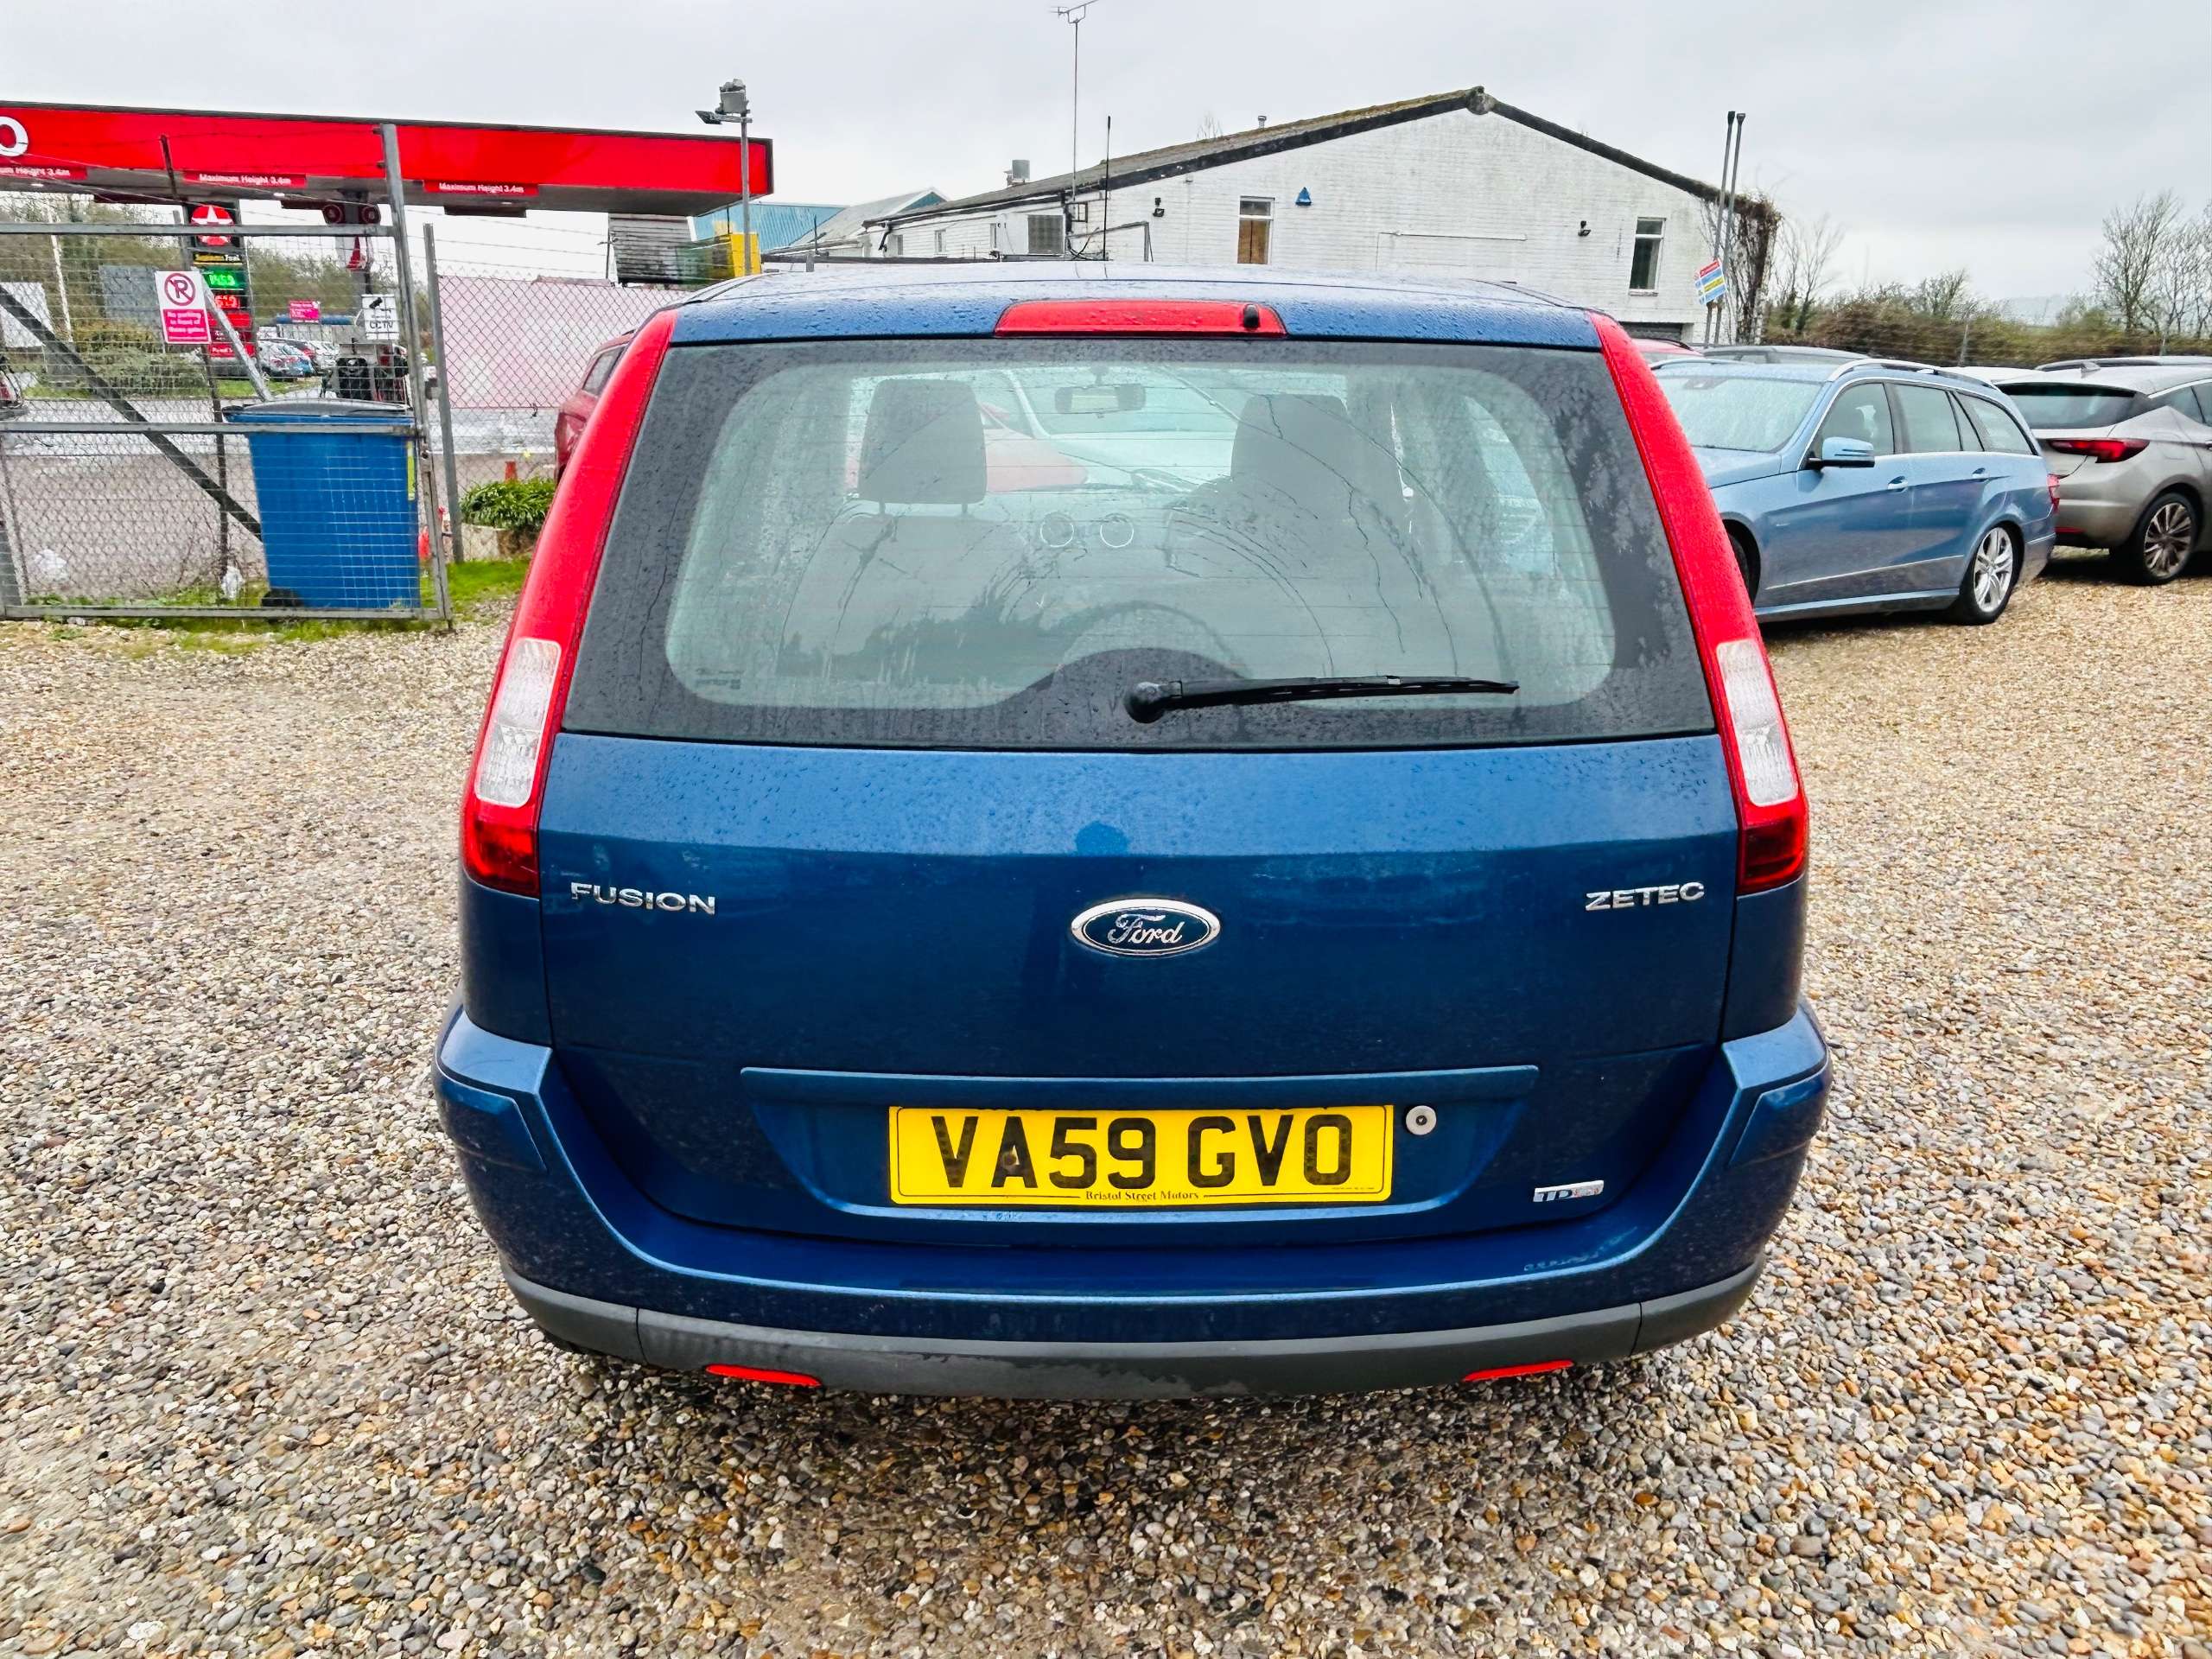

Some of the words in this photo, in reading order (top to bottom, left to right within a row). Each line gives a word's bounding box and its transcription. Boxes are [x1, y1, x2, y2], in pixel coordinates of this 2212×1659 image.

[199, 173, 239, 182] Maximum
[241, 175, 269, 185] Height
[439, 182, 476, 191] Maximum
[477, 184, 504, 194] Height
[570, 881, 715, 916] FUSION
[1585, 881, 1706, 912] ZETEC
[1107, 912, 1185, 944] Ford
[931, 1116, 1157, 1189] VA59
[1187, 1114, 1352, 1187] GVO
[1085, 1191, 1122, 1200] Bristol
[1124, 1191, 1157, 1201] Street
[1160, 1191, 1199, 1199] Motors
